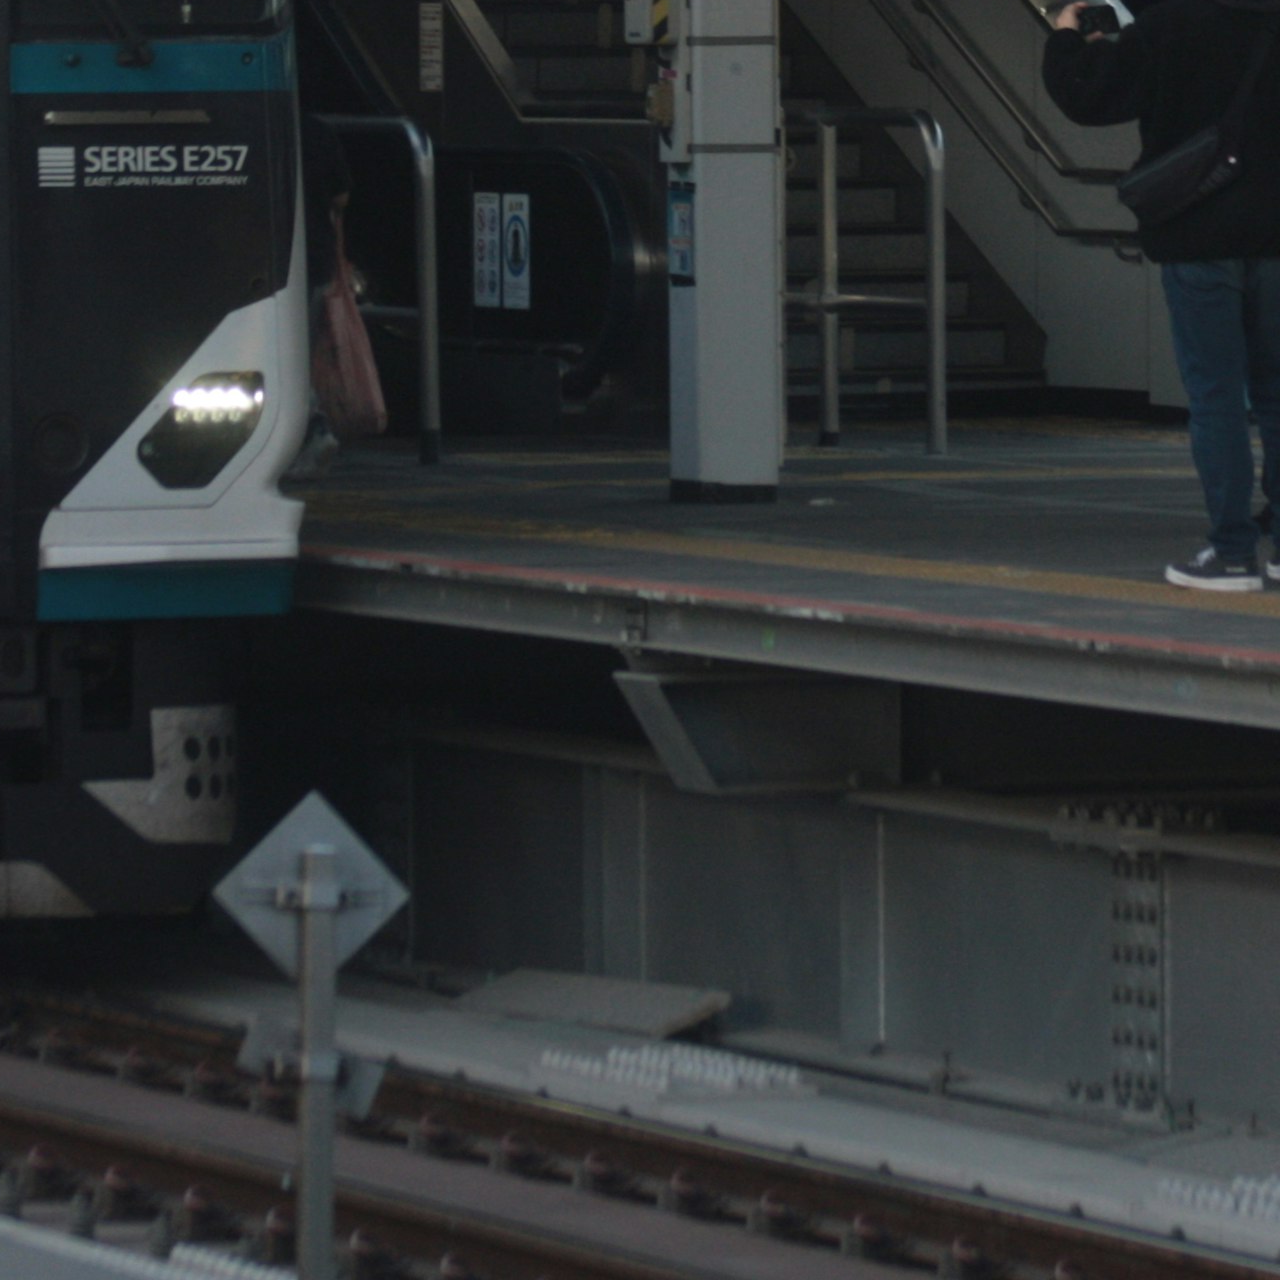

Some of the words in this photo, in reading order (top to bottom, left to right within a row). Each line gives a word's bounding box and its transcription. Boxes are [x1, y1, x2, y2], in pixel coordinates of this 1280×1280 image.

[83, 145, 178, 173] SERIES
[183, 145, 249, 172] E257
[84, 176, 113, 187] EAST
[114, 176, 150, 187] JAPAN
[151, 176, 194, 186] RAILWAY
[196, 176, 249, 186] COMPANY
